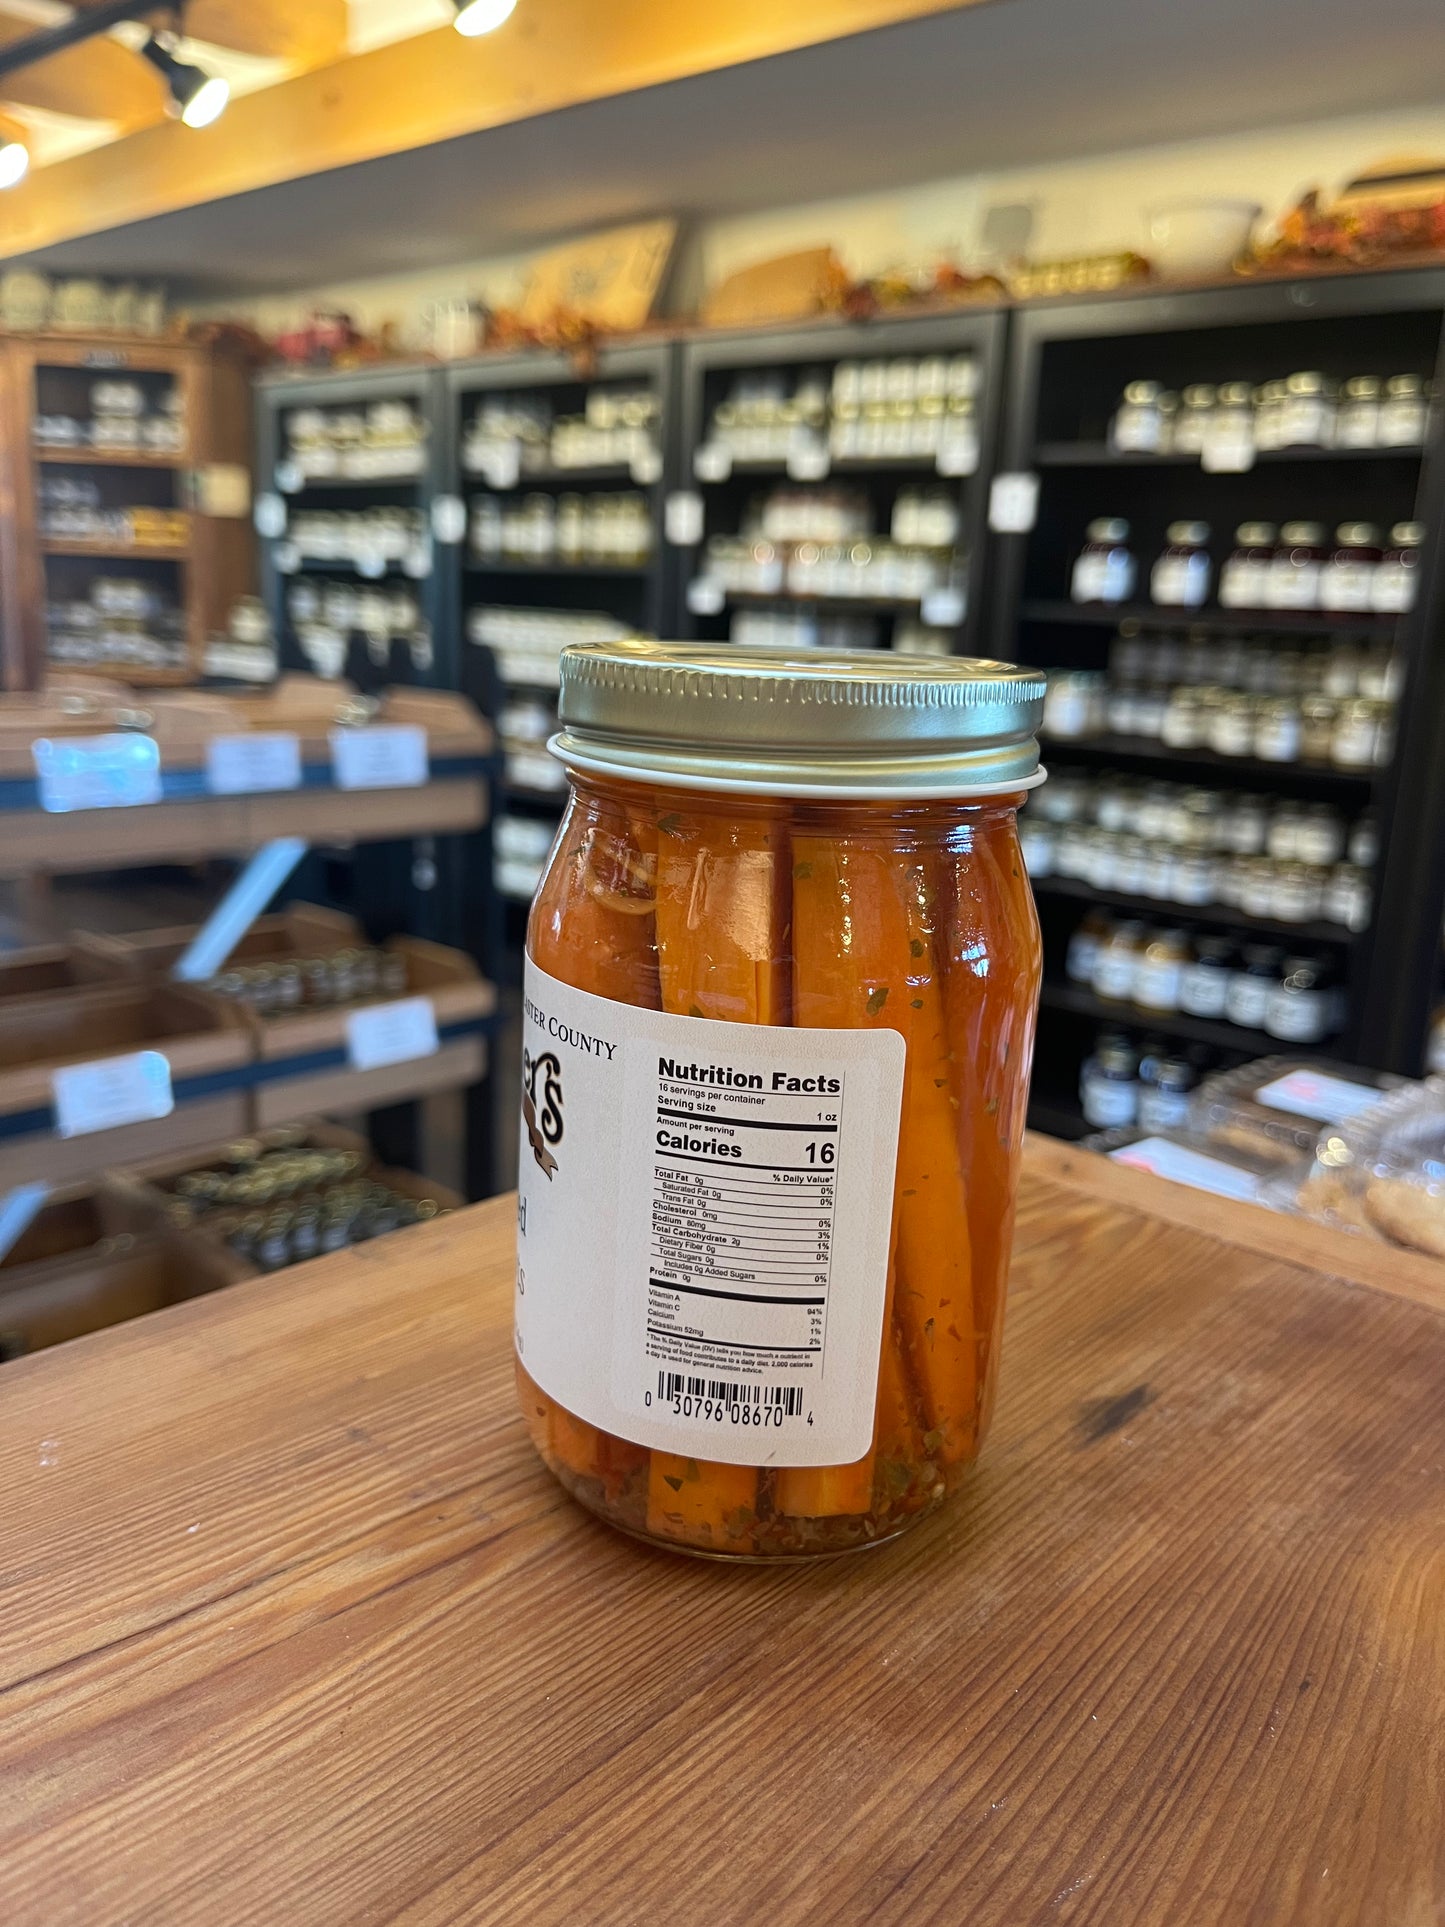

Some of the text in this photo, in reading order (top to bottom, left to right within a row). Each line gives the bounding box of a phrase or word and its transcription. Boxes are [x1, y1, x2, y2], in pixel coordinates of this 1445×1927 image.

[659, 1057, 840, 1093] Nutrition Facts
[659, 1083, 766, 1105] 16 servings per container
[658, 1096, 694, 1110] Serving
[697, 1102, 716, 1112] size
[657, 1116, 735, 1136] Amount per serving
[656, 1130, 835, 1163] Calories 16
[655, 1169, 673, 1179] Total
[676, 1173, 688, 1181] Fat
[695, 1177, 703, 1185] 0g
[773, 1174, 780, 1182] %
[783, 1175, 804, 1184] Daily
[662, 1182, 695, 1194] Saturated
[697, 1188, 709, 1196] Fat
[712, 1191, 721, 1199] 0g
[662, 1193, 706, 1208] Trans Fat 0g
[652, 1213, 681, 1225] Sodium
[653, 1202, 697, 1216] Cholesterol
[703, 1211, 717, 1220] 0mg
[652, 1224, 670, 1233] Total
[673, 1228, 727, 1243] Carbohydrate
[732, 1238, 740, 1246] 2g
[660, 1237, 683, 1248] Dietary
[685, 1241, 703, 1250] Fiber
[706, 1245, 715, 1253] 0g
[660, 1248, 714, 1264] Total Sugars 0g
[650, 1267, 691, 1282] Protein 0g
[664, 1260, 692, 1271] Includes
[695, 1265, 703, 1273] 0g
[705, 1267, 728, 1276] Added
[730, 1270, 755, 1280] Sugars
[649, 1288, 673, 1300] Vitamin
[648, 1298, 673, 1310] Vitamin
[648, 1308, 674, 1320] Calcium
[647, 1318, 682, 1332] Potassium
[684, 1326, 703, 1337] 52mg
[651, 1343, 671, 1353] serving
[680, 1349, 692, 1357] food
[694, 1352, 726, 1363] contributes
[669, 1339, 682, 1347] Daily
[730, 1349, 741, 1357] you
[650, 1350, 660, 1358] day
[668, 1354, 682, 1362] used
[693, 1359, 714, 1368] general
[716, 1361, 740, 1371] nutrition
[645, 1391, 813, 1427] 0 30796 08670 4
